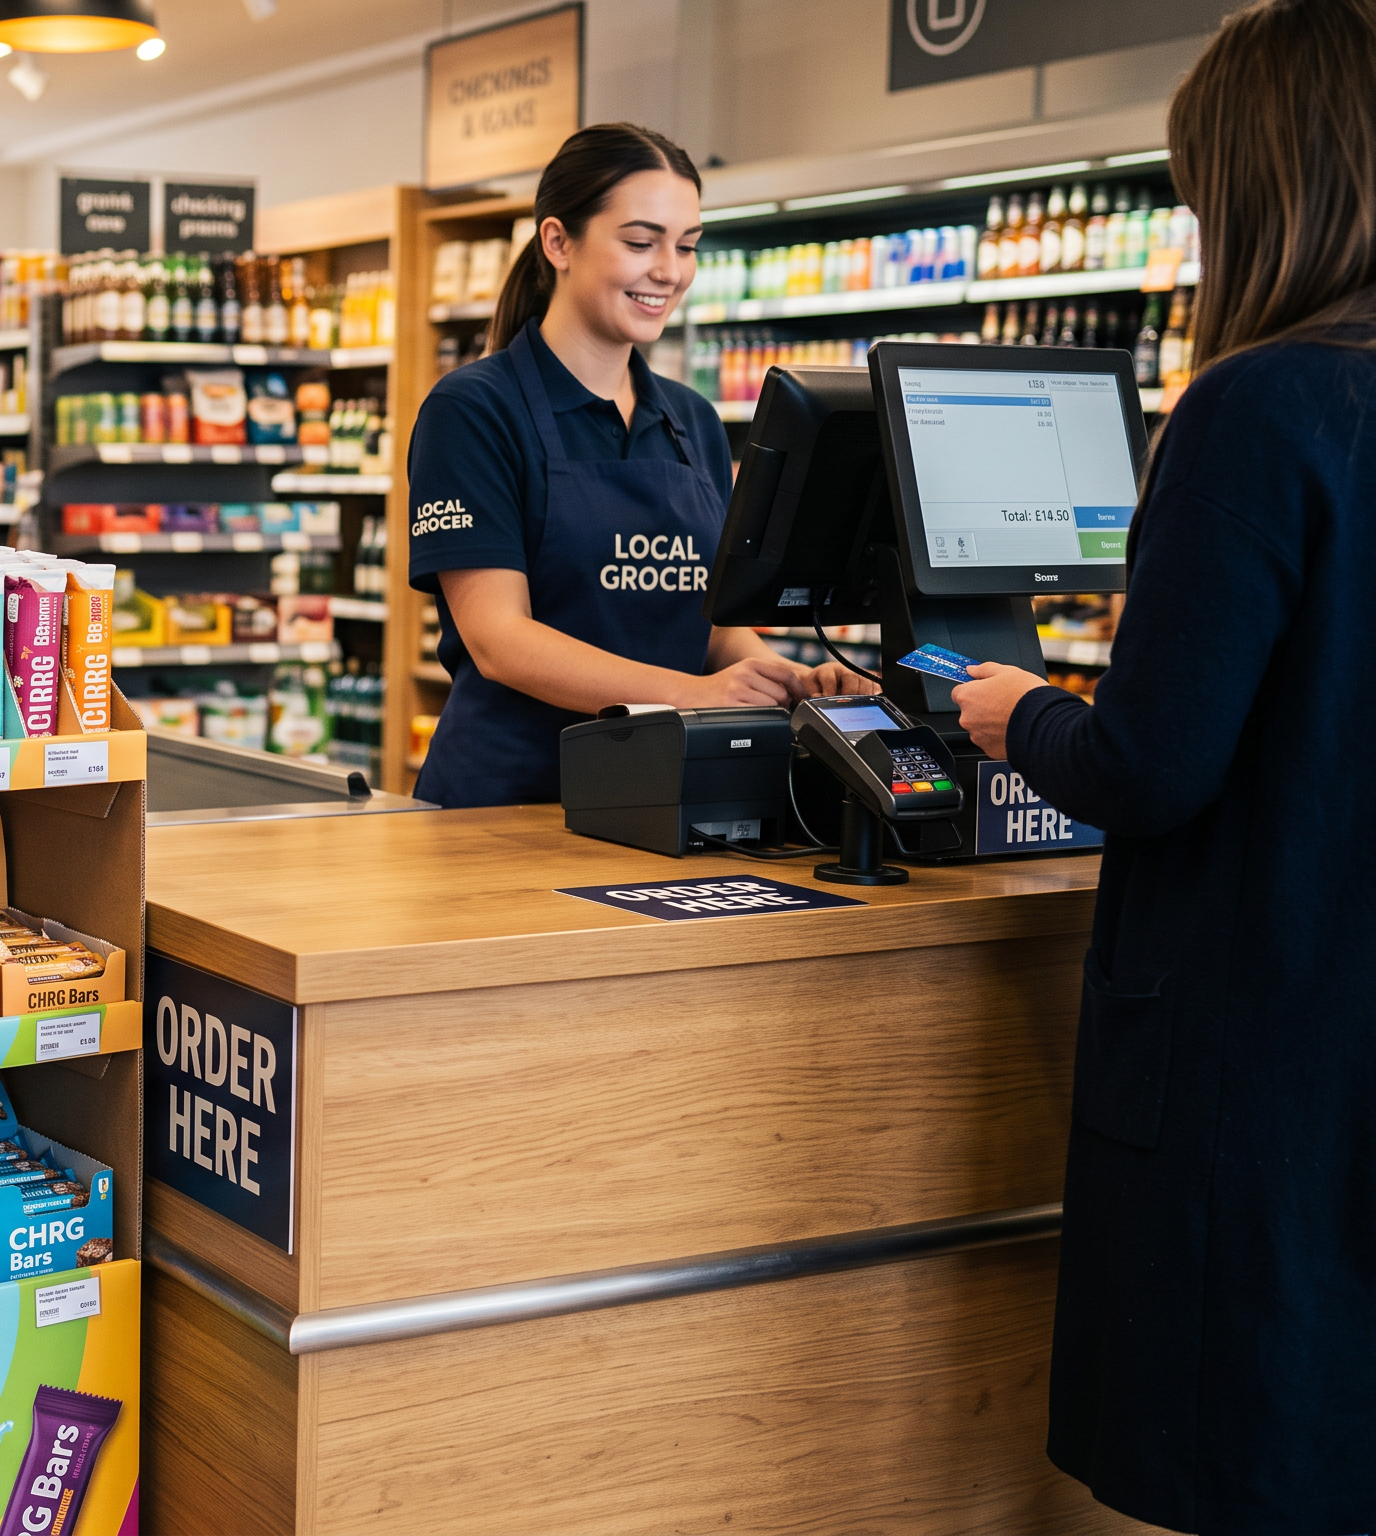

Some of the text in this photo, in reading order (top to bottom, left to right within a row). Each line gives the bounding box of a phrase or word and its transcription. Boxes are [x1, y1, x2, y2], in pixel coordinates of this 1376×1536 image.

[417, 499, 466, 519] LOCAL
[1001, 510, 1032, 522] Total:
[412, 514, 473, 537] GROCER
[615, 533, 700, 561] LOCAL
[600, 564, 708, 592] GROCER
[82, 654, 109, 727] CIRRG
[990, 772, 1041, 806] ORD
[1006, 808, 1073, 843] HERE
[605, 881, 777, 902] ORDER
[661, 892, 810, 913] HERE
[28, 987, 99, 1009] CHRG Bars
[156, 995, 276, 1114] ORDER
[169, 1083, 261, 1196] HERE
[9, 1216, 85, 1251] CHRG
[10, 1248, 53, 1272] Bars
[30, 1424, 80, 1500] Bars
